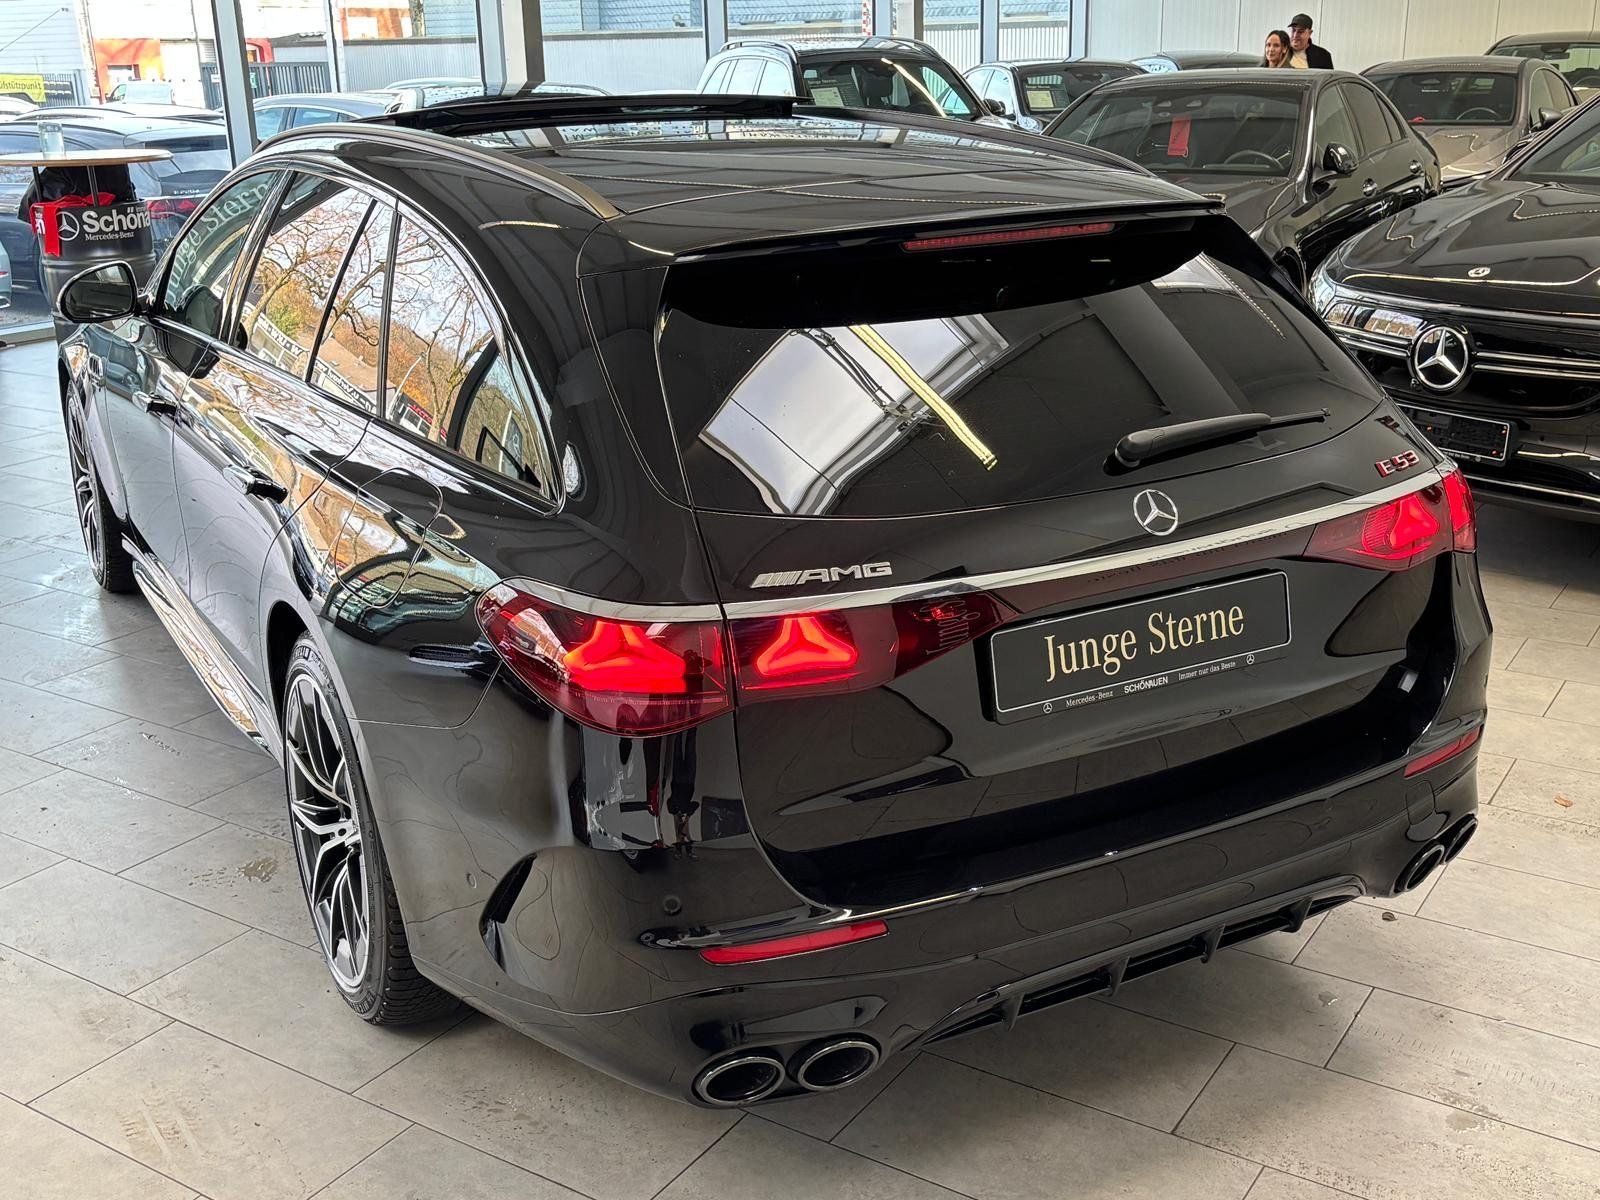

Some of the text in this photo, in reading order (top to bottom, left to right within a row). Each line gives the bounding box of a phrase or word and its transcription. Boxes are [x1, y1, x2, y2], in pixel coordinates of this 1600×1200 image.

[201, 183, 268, 233] Stern
[85, 231, 134, 241] Mercedes-Benz
[796, 561, 893, 585] AMG
[1044, 604, 1245, 683] Junge Sterne
[1065, 661, 1236, 708] Mercedes-Benz SCHÖNAUEN Immer nur das Beste
